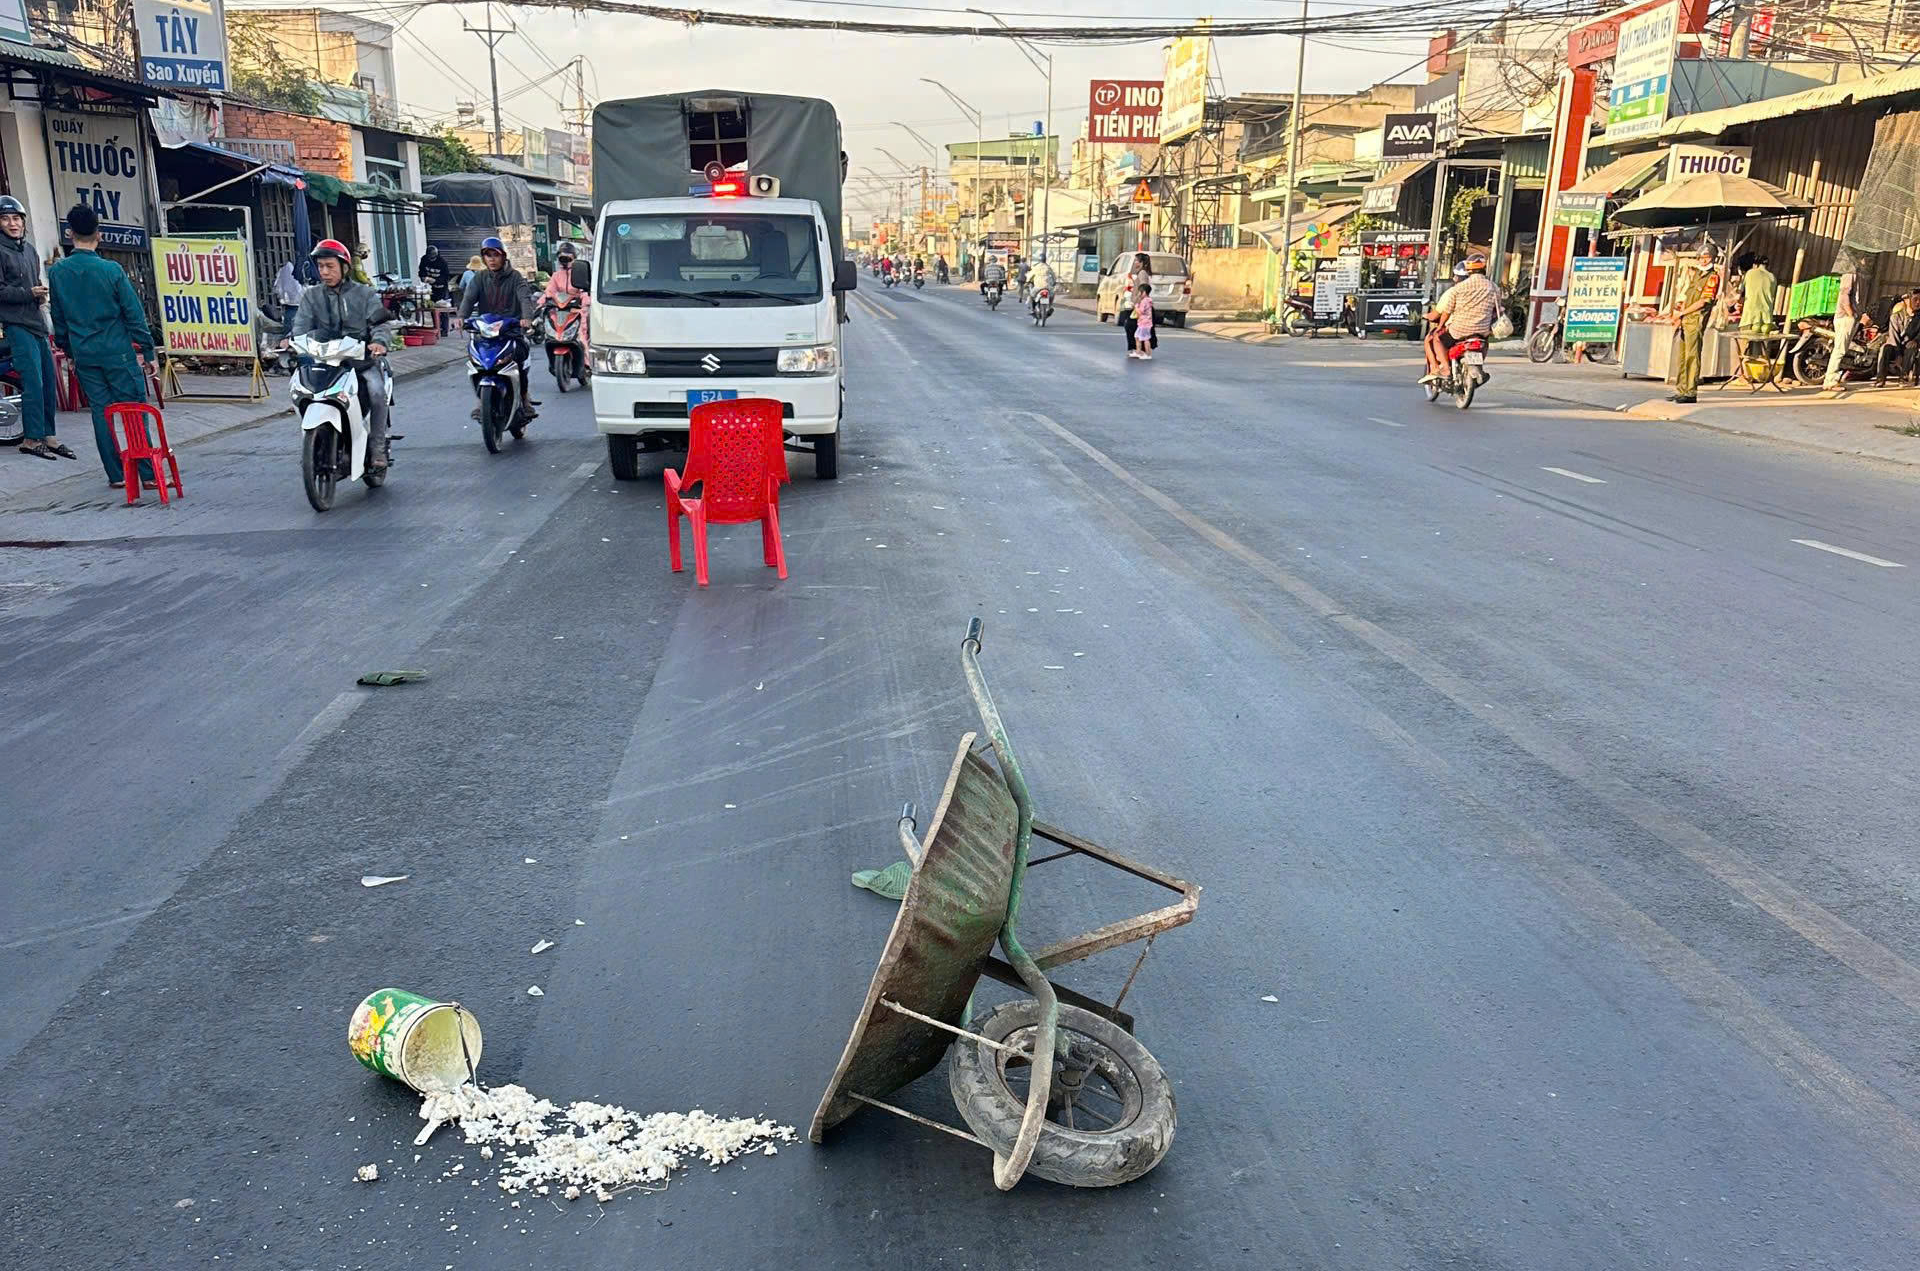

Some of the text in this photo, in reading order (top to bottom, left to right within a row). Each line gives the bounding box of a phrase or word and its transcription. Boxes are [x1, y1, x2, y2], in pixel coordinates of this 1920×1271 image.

[155, 8, 198, 55] TÂY
[145, 62, 220, 85] Sao Xuyến
[1099, 90, 1116, 102] TP
[1094, 108, 1130, 137] TIẾN
[1387, 125, 1433, 140] AVA
[54, 136, 137, 178] THUỐC
[1679, 150, 1745, 174] THUỐC
[76, 183, 121, 220] TÂY
[165, 243, 239, 285] HỦ TIẾU
[1596, 283, 1618, 296] YẾN
[164, 290, 249, 325] BÚN RIÊU
[1380, 304, 1410, 314] AVA
[1569, 310, 1615, 323] Salonpas
